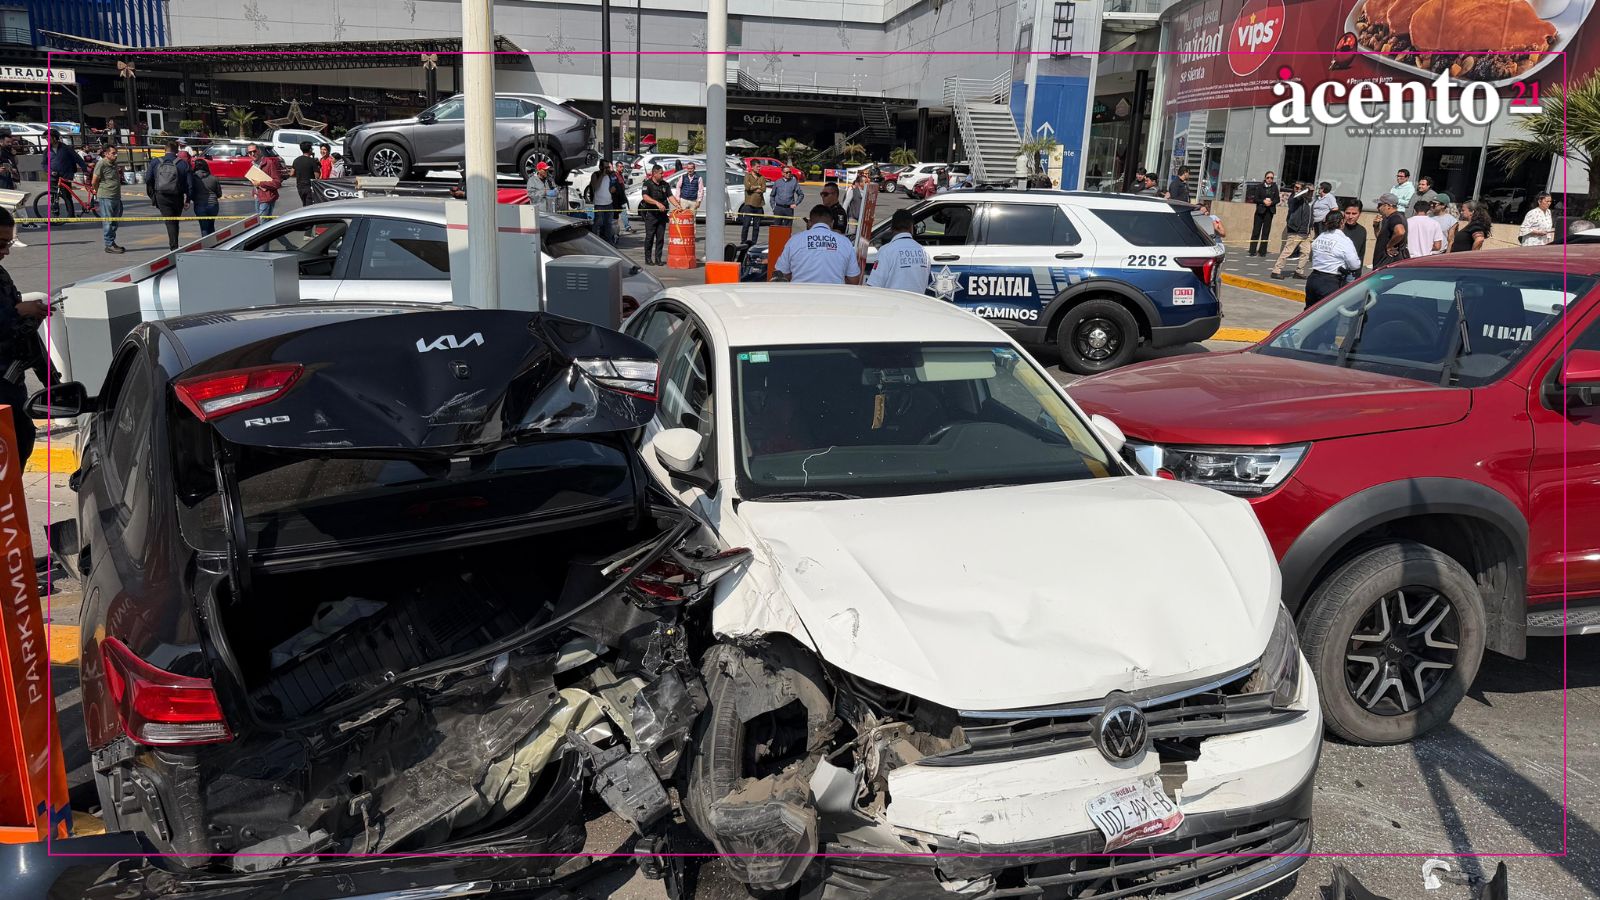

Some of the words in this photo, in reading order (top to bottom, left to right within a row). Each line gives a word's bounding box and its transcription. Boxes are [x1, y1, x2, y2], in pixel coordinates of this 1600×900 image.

[1177, 24, 1224, 67] Navidad
[0, 67, 54, 78] TRADA
[743, 114, 782, 125] escarlata
[1127, 255, 1167, 267] 2262
[968, 276, 1032, 297] ESTATAL
[976, 306, 1038, 320] CAMINOS
[416, 332, 484, 353] KIA
[244, 415, 290, 428] RIO
[0, 493, 43, 704] PARKIMOVIL
[1115, 785, 1137, 798] PUEBLA
